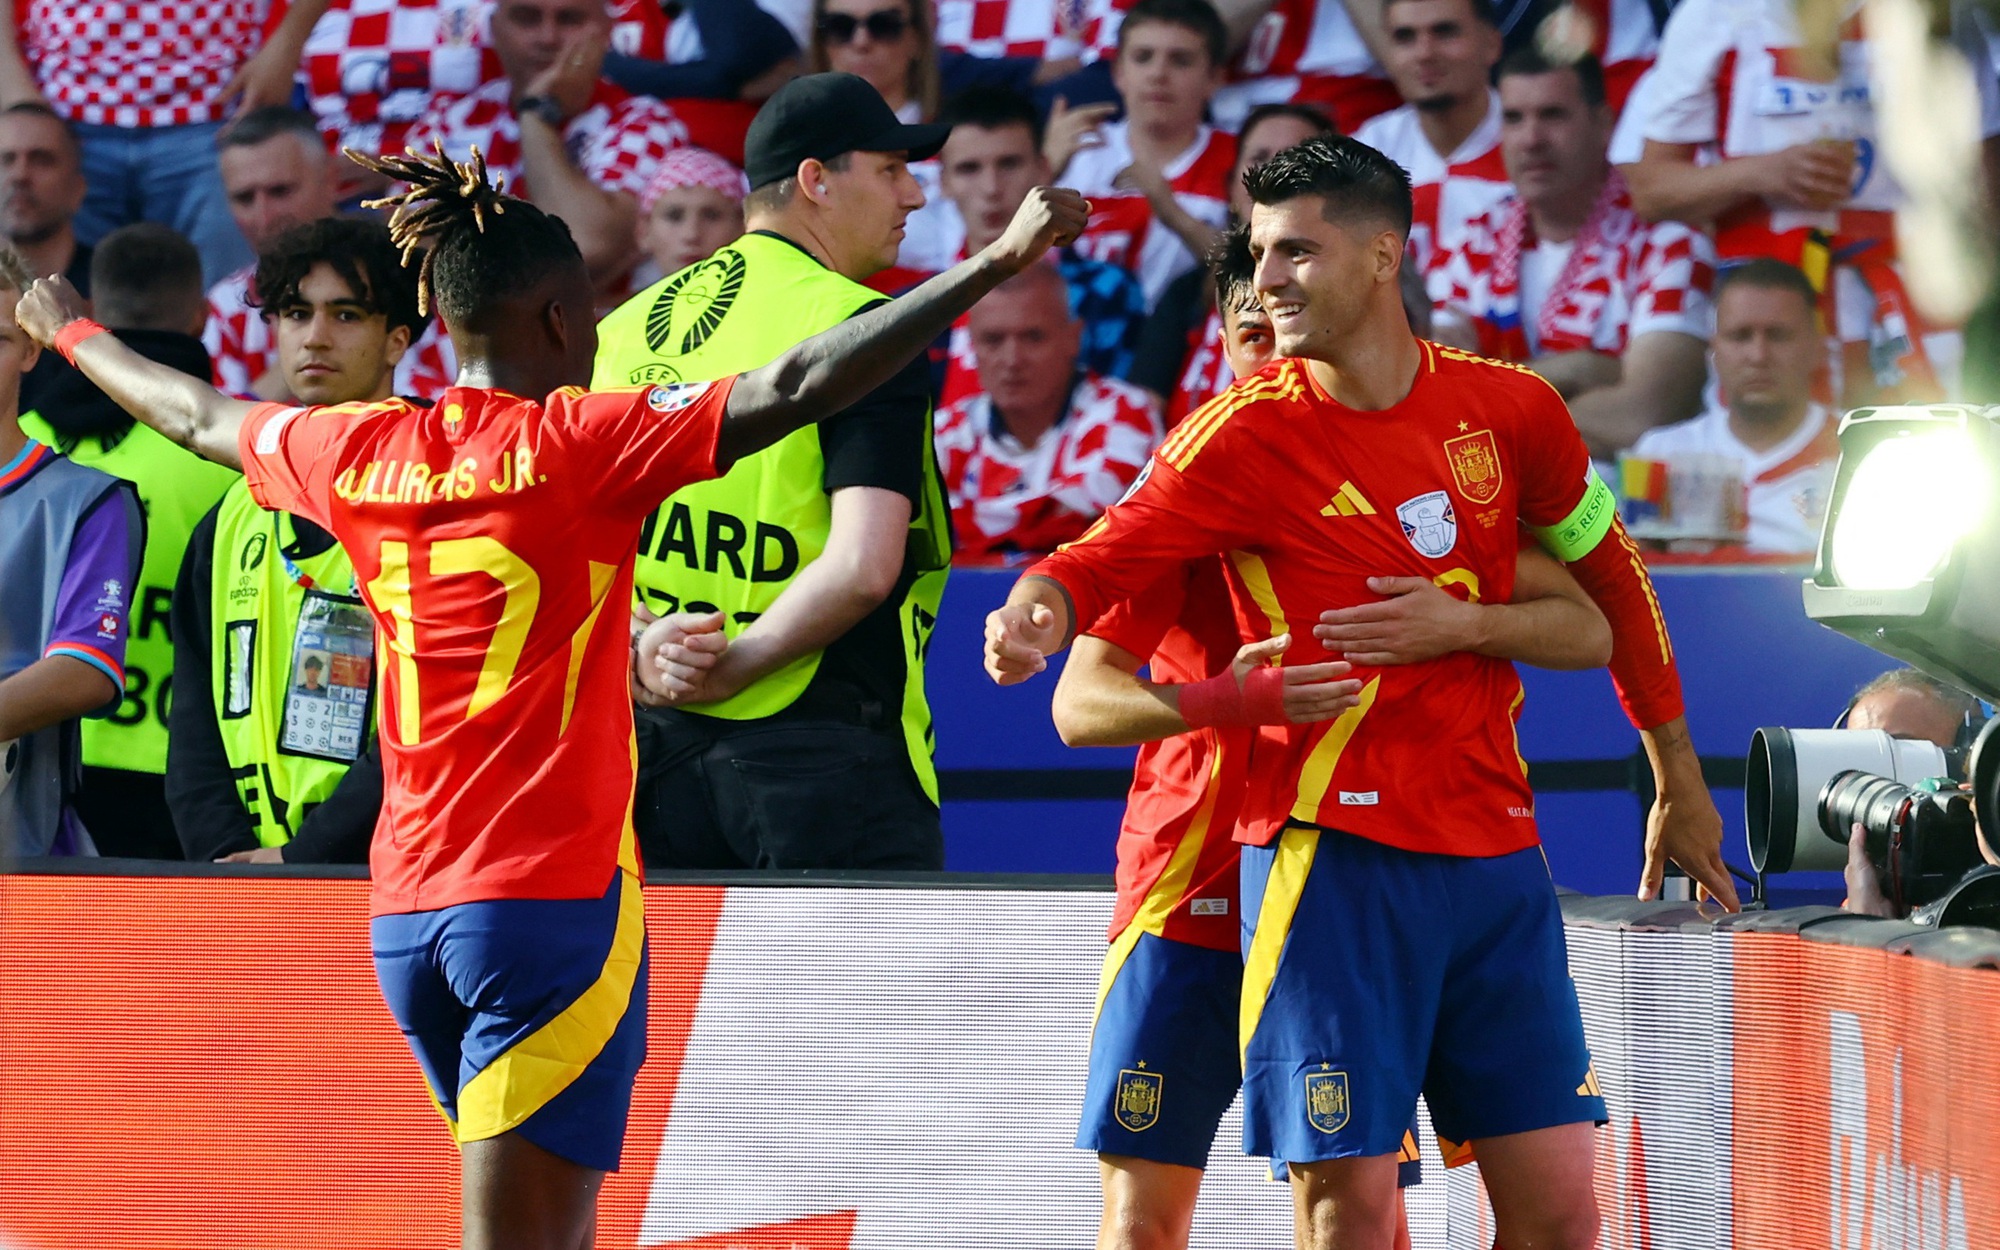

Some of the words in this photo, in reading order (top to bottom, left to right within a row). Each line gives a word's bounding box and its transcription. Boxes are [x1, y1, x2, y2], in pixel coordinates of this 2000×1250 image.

[630, 368, 677, 386] UEF
[488, 447, 548, 493] JR.
[366, 536, 541, 746] 17
